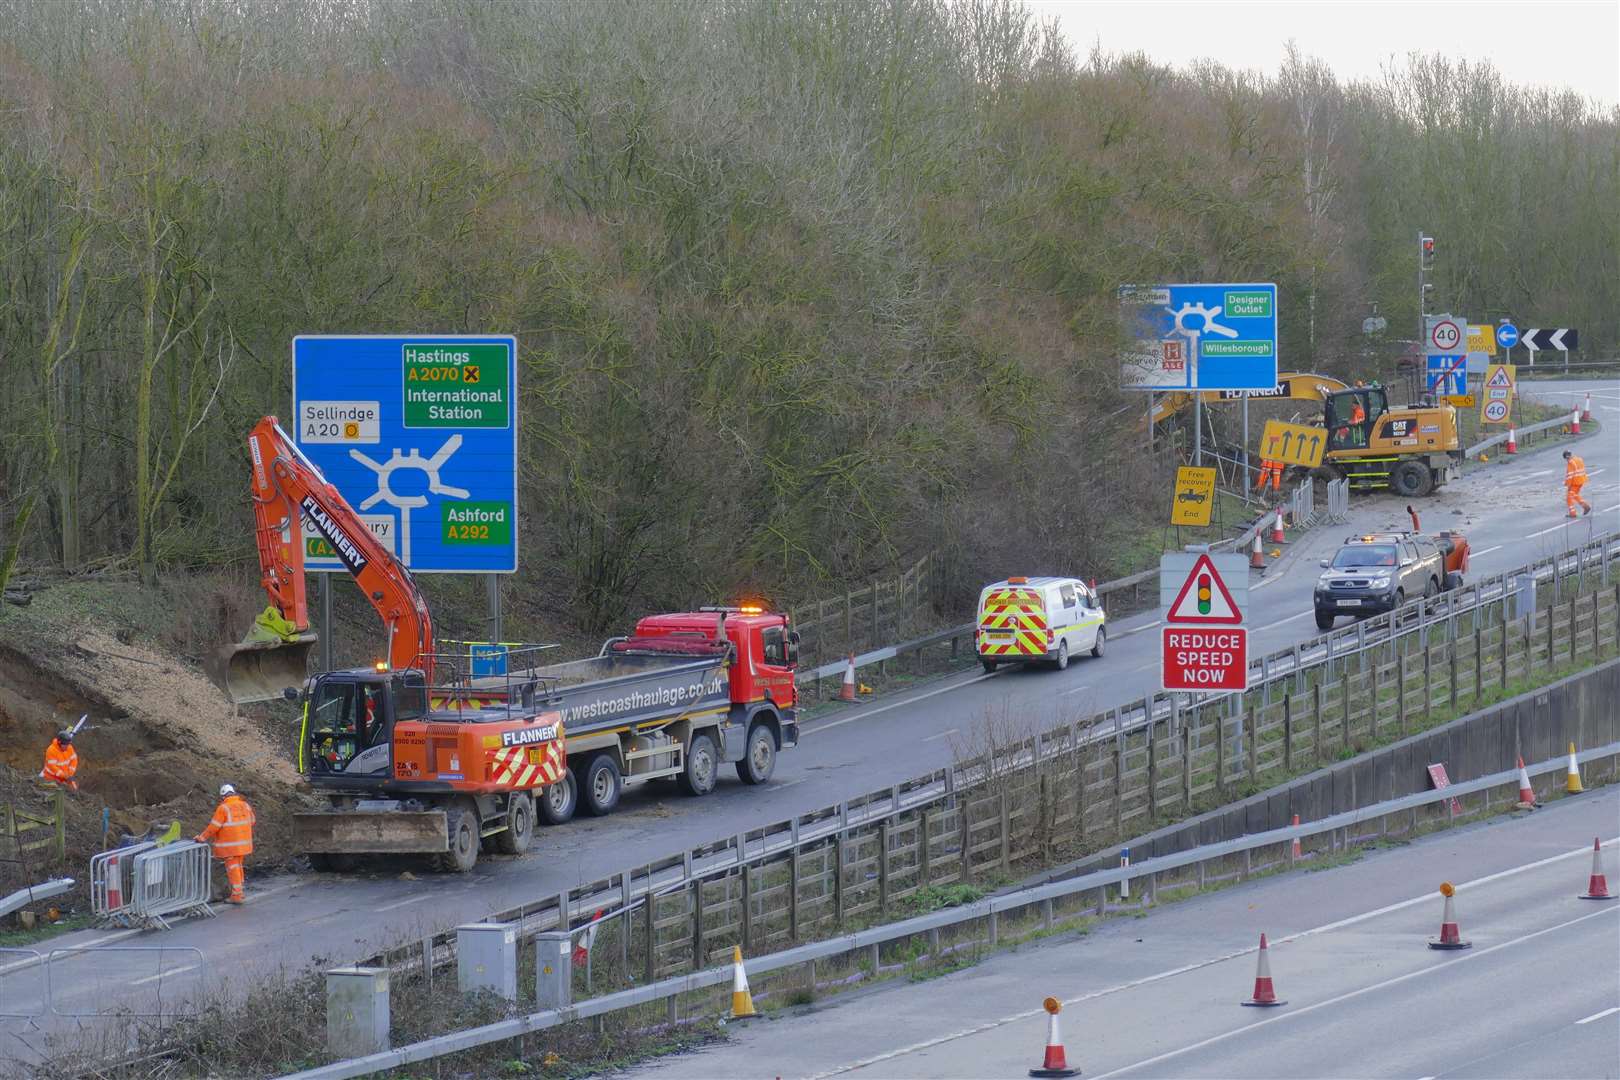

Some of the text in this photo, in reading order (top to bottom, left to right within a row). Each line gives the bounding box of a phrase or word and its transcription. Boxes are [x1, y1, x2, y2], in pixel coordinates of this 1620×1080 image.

[1229, 295, 1268, 305] Designer
[1234, 305, 1263, 313] Outlet
[1436, 329, 1457, 341] 40
[1205, 344, 1269, 354] Willesborough
[405, 349, 470, 365] Hastings
[407, 388, 502, 403] International
[306, 406, 374, 421] Sellindge
[428, 405, 483, 419] Station
[1487, 406, 1505, 415] 40
[306, 423, 339, 436] A20
[1392, 420, 1408, 431] CAT
[1188, 470, 1205, 478] Free
[1178, 479, 1212, 488] recovery
[447, 507, 505, 523] Ashford
[1183, 510, 1200, 518] End
[303, 496, 366, 568] FLANNERY
[447, 525, 489, 539] A292
[1169, 634, 1240, 649] REDUCE
[1176, 652, 1233, 666] SPEED
[1183, 669, 1225, 683] NOW
[503, 720, 560, 746] FLANNERY
